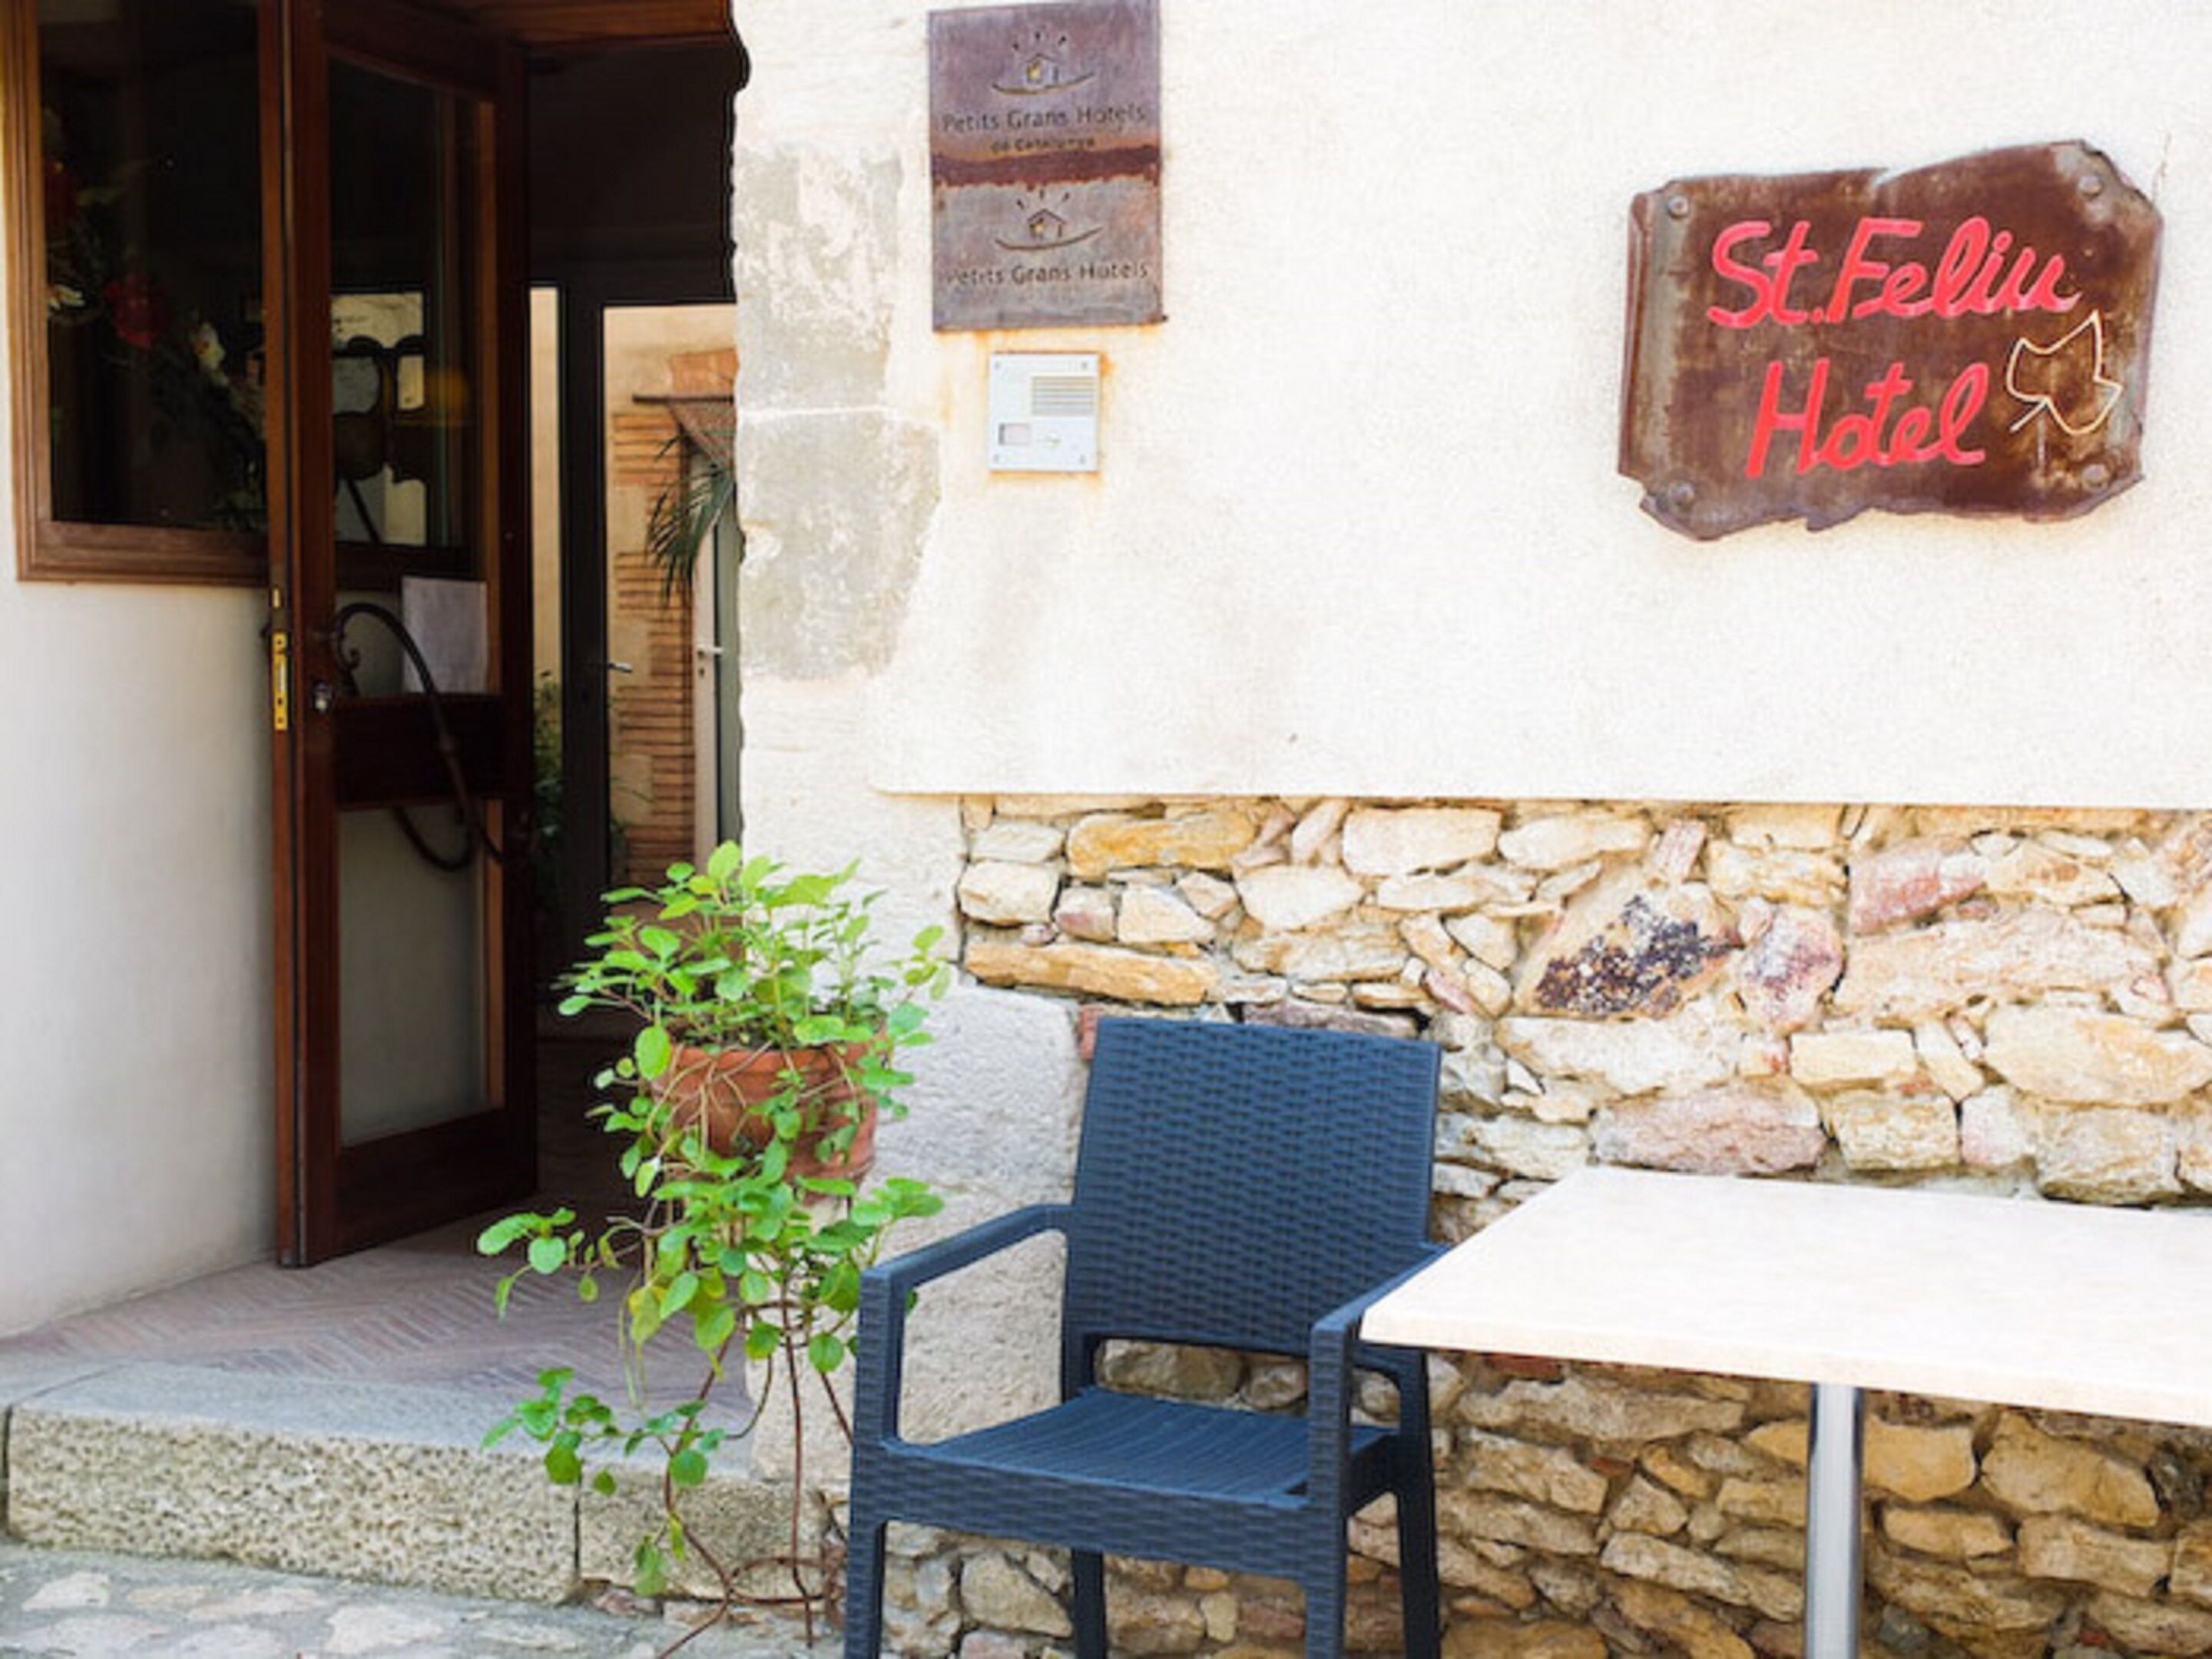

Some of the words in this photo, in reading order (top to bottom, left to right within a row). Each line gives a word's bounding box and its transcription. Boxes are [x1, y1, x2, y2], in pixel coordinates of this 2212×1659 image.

[942, 112, 1000, 133] Petits
[1007, 109, 1069, 130] Grans
[1077, 103, 1147, 124] Hotels
[1011, 263, 1071, 286] Grans
[1080, 260, 1148, 280] Hotels
[1745, 357, 1991, 479] Hotel
